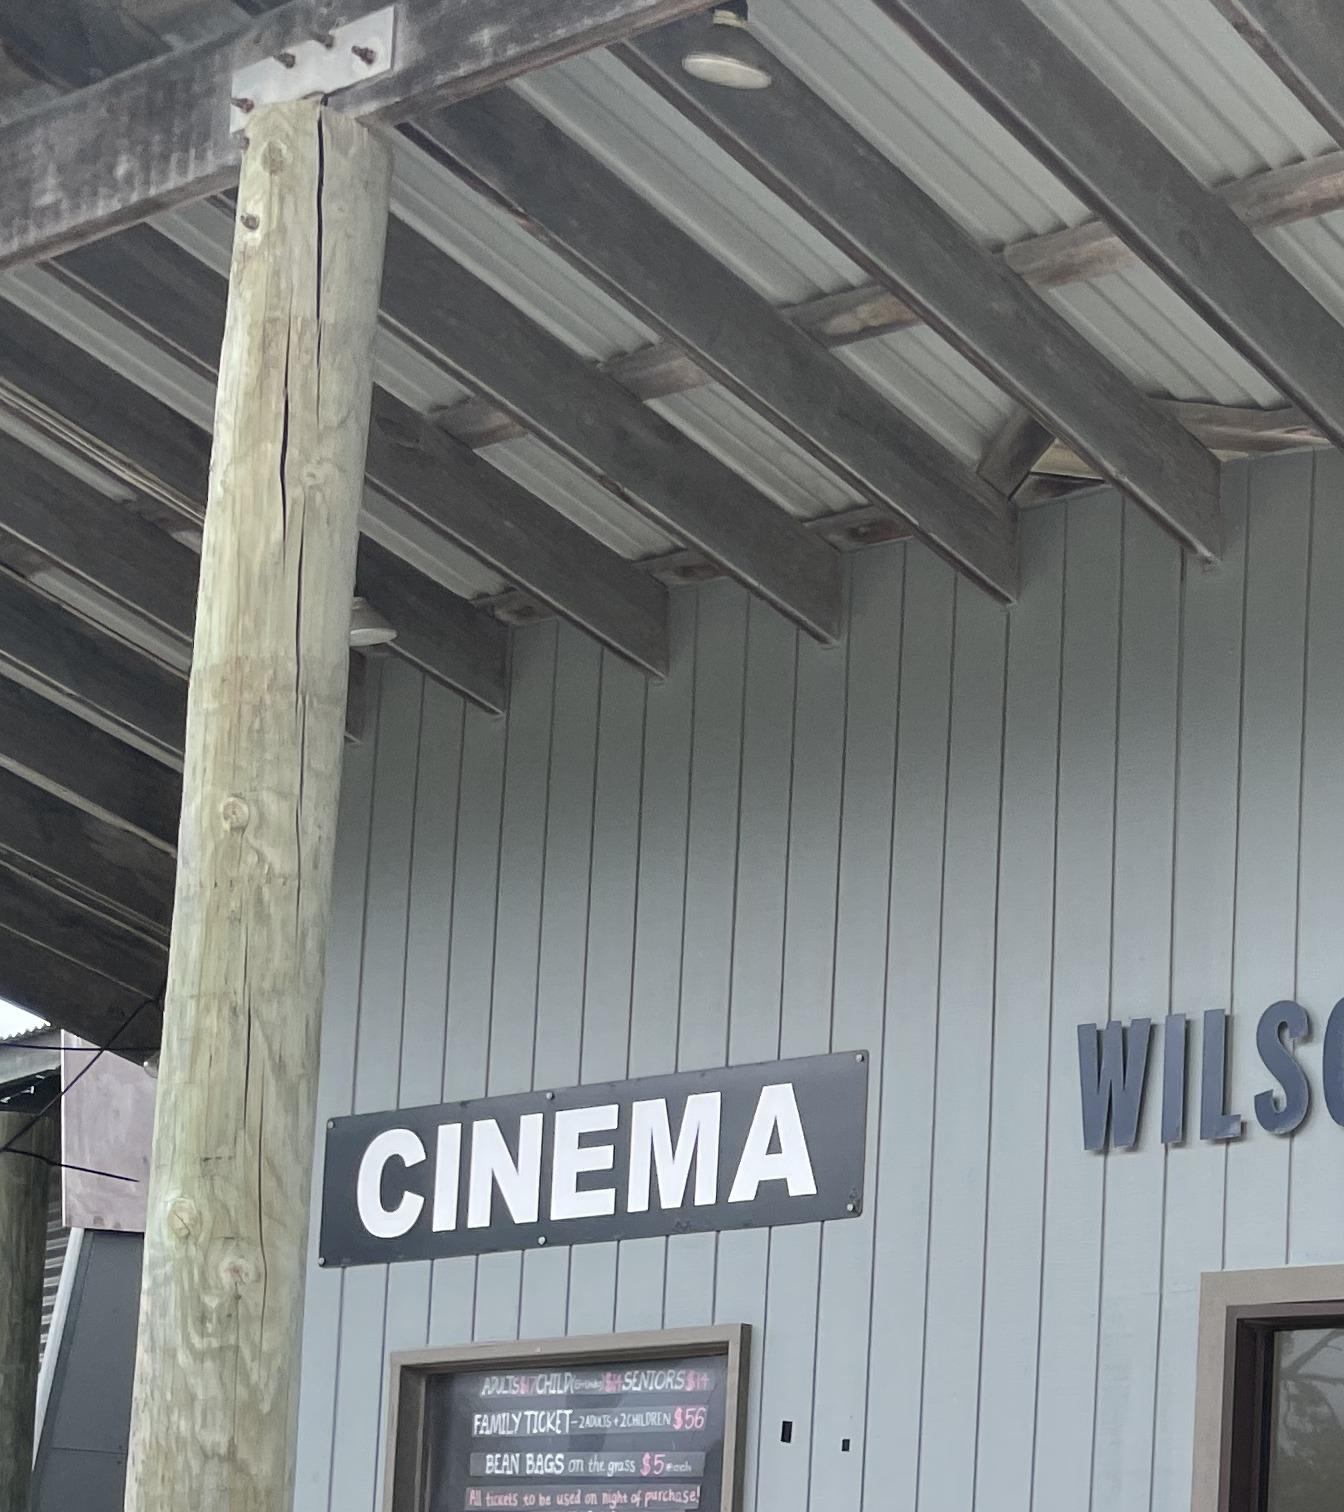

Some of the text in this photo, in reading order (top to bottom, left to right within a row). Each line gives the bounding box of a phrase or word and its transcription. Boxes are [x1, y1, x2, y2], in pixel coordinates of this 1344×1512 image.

[356, 1082, 818, 1239] CINEMA
[622, 1369, 685, 1391] SENIORS
[473, 1411, 521, 1435] FAMILY
[523, 1409, 573, 1434] TICKET
[672, 1406, 706, 1430] $56
[485, 1451, 692, 1477] BEAN BAGS on the grass $5 each
[469, 1484, 701, 1509] All tickets to be used on night of purchase!
